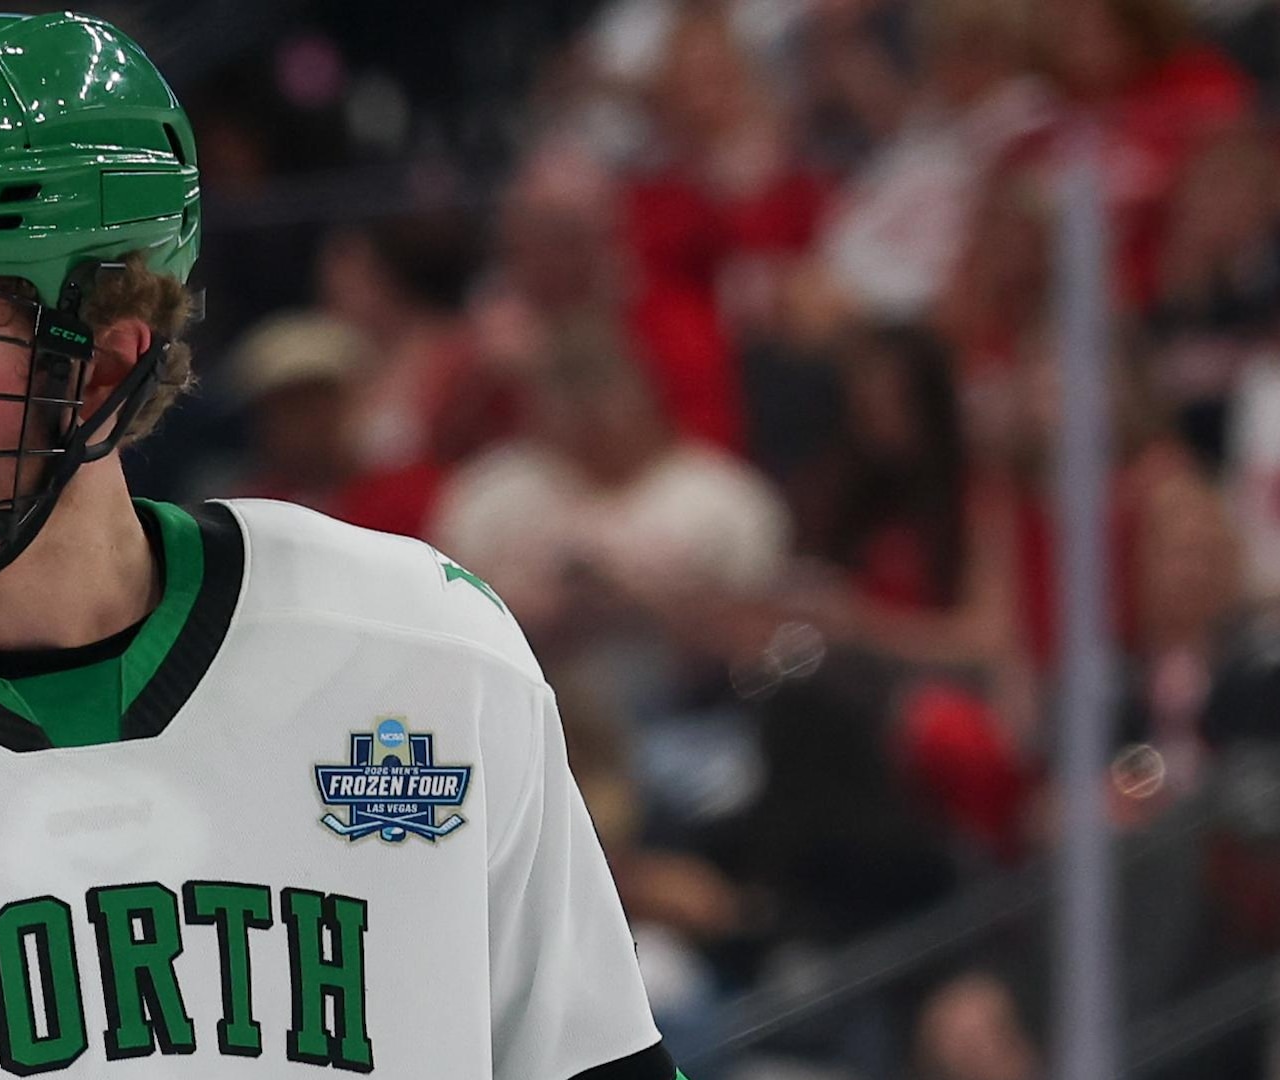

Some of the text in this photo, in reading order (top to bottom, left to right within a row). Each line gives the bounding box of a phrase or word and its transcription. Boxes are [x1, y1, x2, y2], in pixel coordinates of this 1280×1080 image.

[50, 325, 88, 345] CCM
[391, 766, 419, 775] MEN'S
[329, 775, 458, 797] FROZEN FOUR
[366, 803, 418, 814] LAS VEGAS
